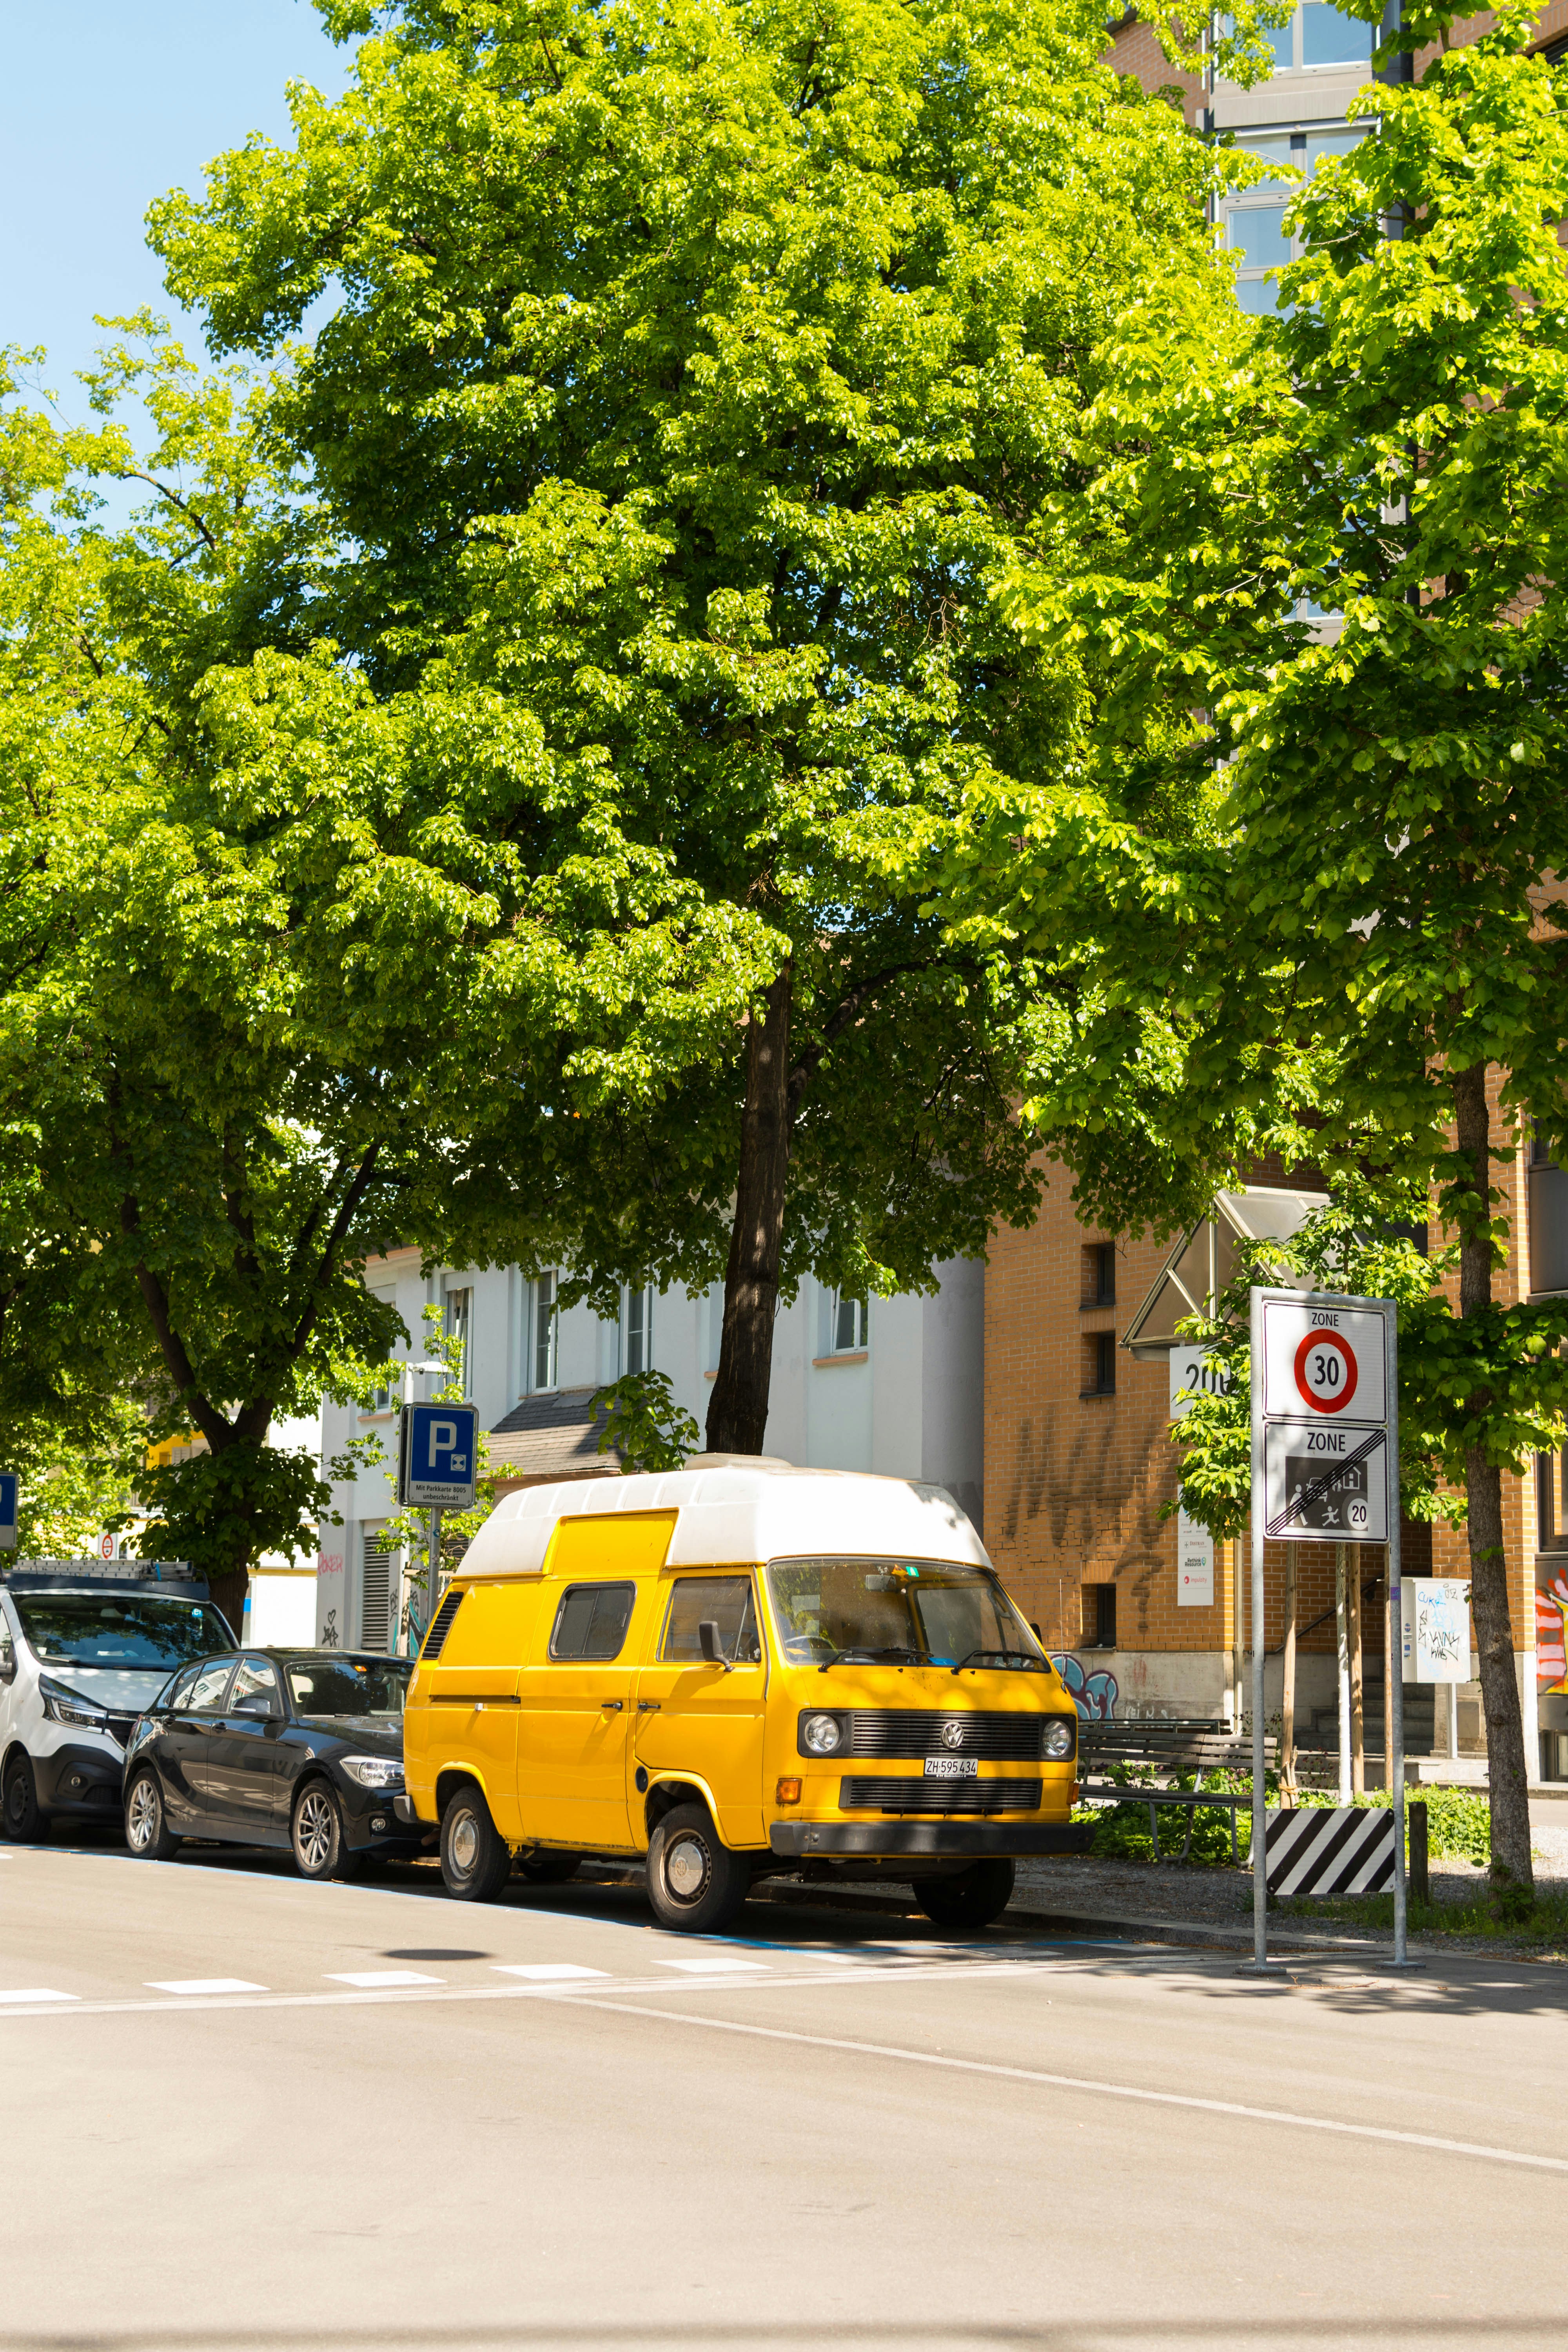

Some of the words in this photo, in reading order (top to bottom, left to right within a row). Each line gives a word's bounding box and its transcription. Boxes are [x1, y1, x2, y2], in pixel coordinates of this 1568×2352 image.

[1312, 1312, 1339, 1327] ZONE
[1314, 1355, 1339, 1386] 30
[429, 1421, 457, 1467] P
[1307, 1432, 1346, 1452] ZONE
[1352, 1505, 1367, 1522] 20
[942, 1722, 964, 1749] VW
